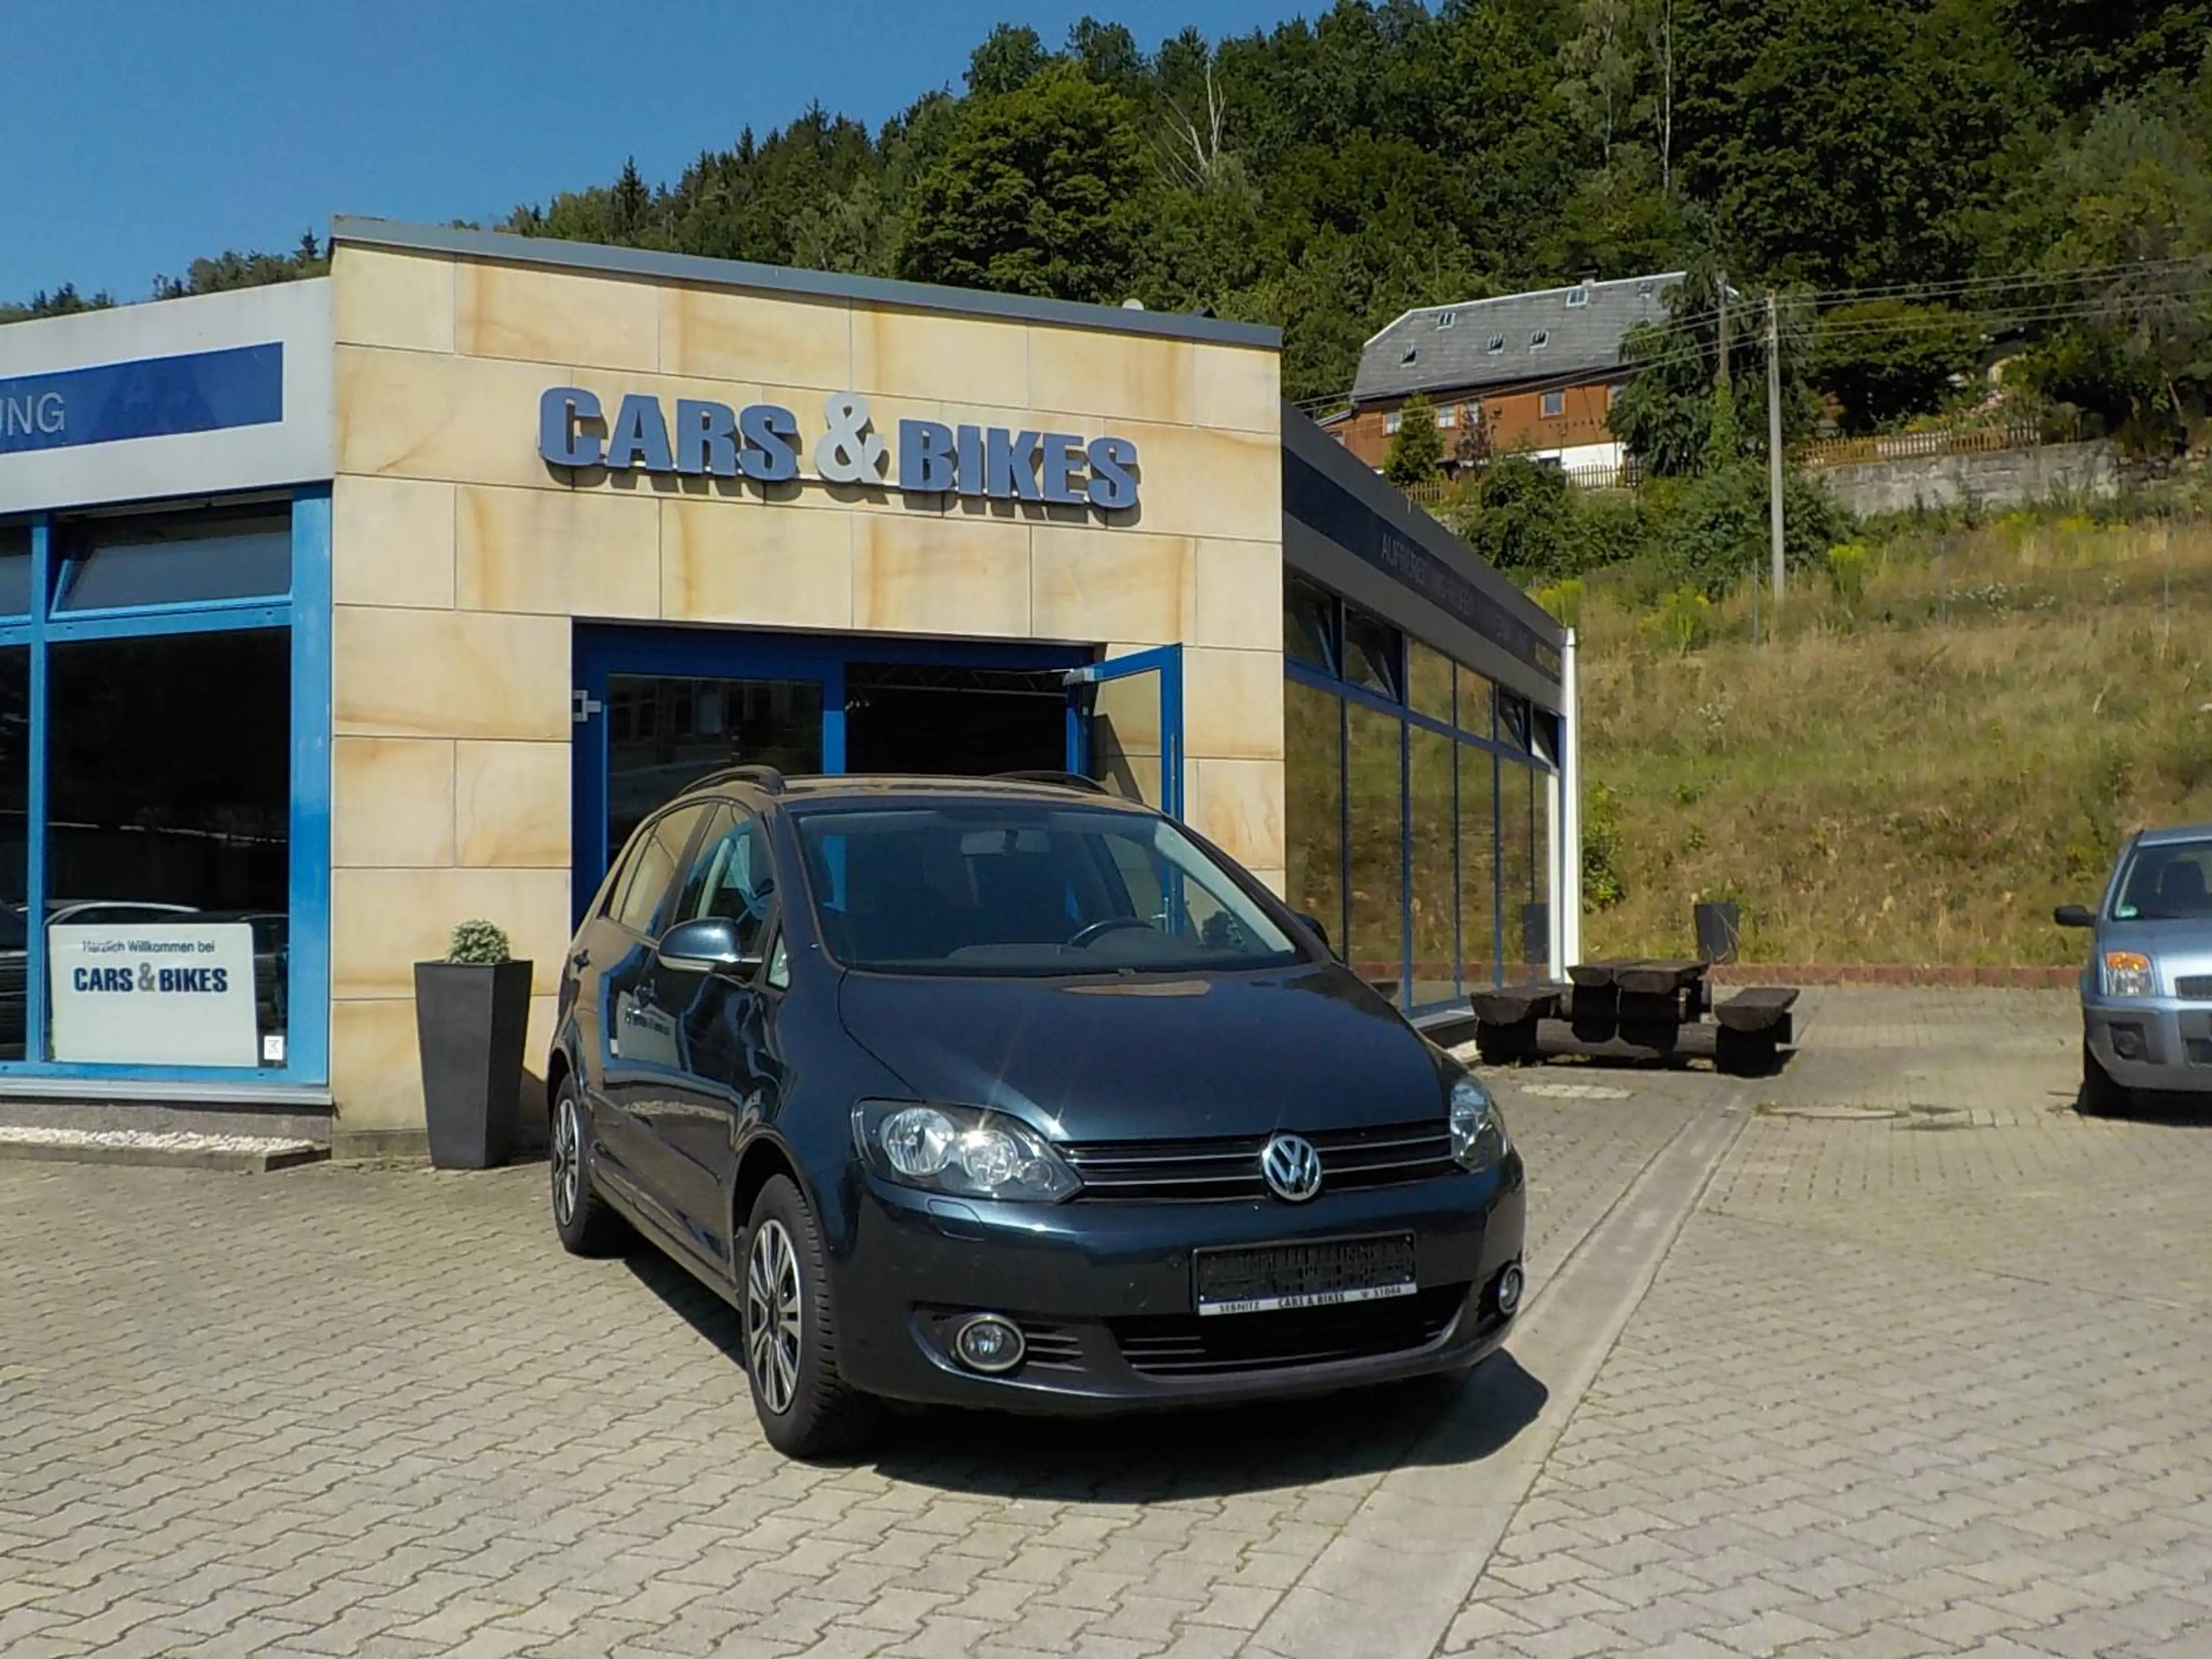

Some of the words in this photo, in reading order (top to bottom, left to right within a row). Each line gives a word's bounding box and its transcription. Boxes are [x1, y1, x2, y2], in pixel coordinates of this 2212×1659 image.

[0, 392, 65, 436] NG
[539, 387, 797, 480] CARS
[814, 391, 885, 484] &
[899, 418, 1138, 509] BIKES
[128, 940, 194, 953] Willkommen
[198, 940, 215, 953] bei
[74, 967, 133, 992] CARS
[138, 963, 156, 991] &
[159, 968, 228, 992] BIKES
